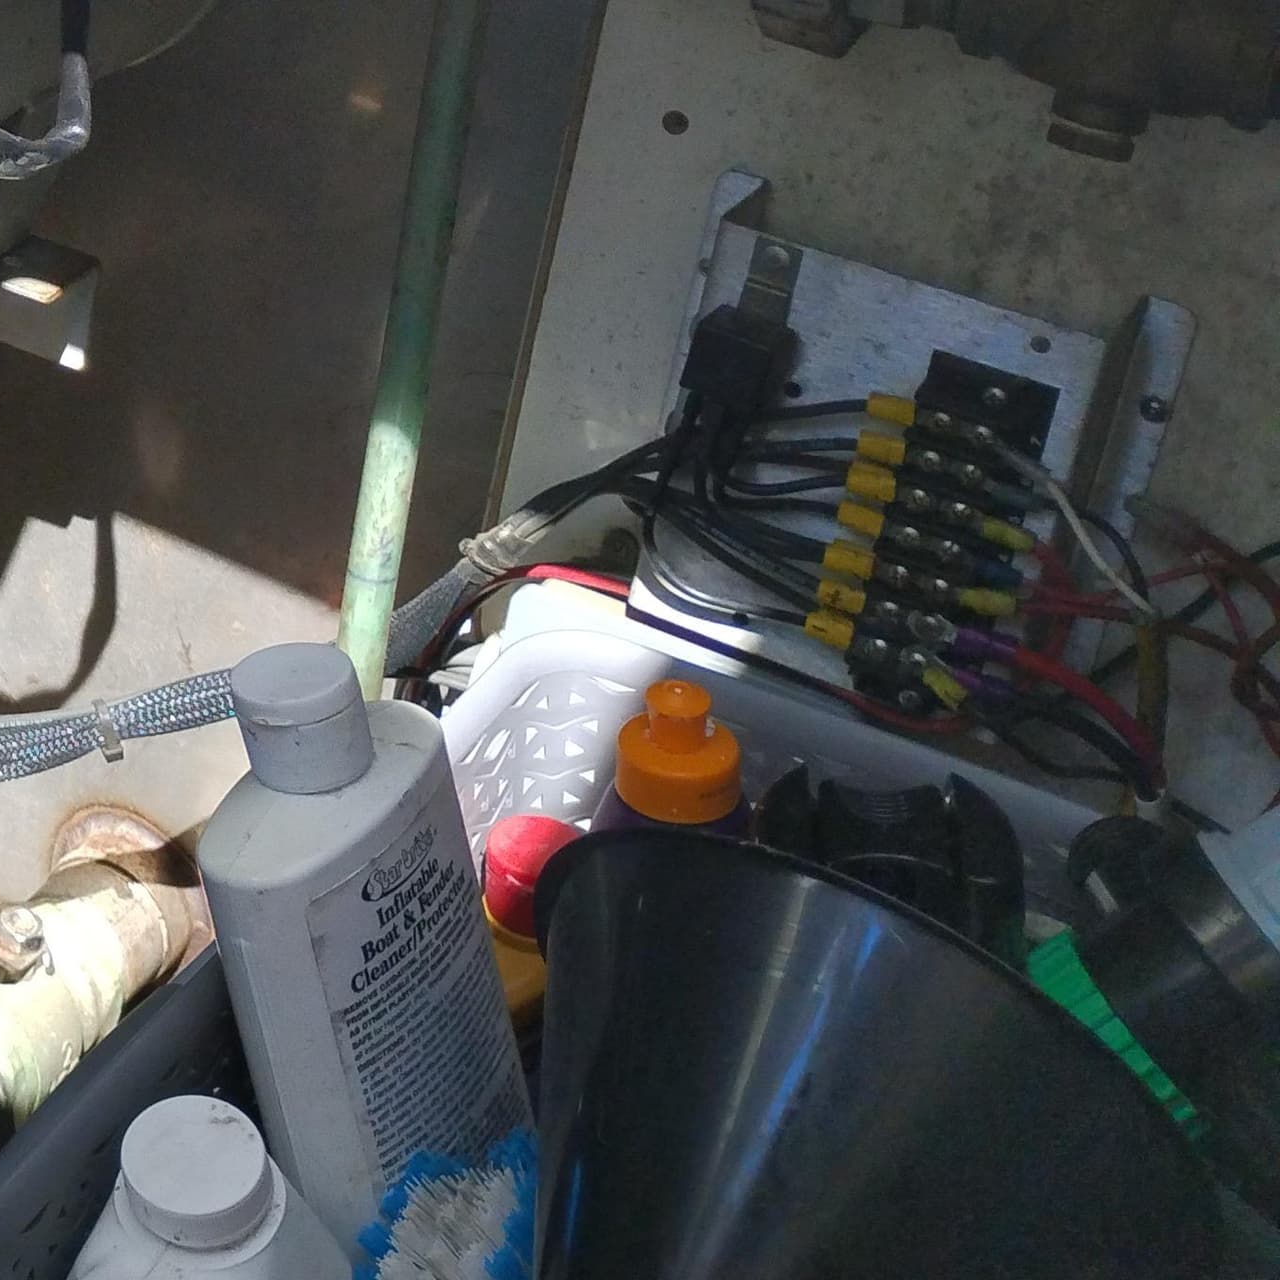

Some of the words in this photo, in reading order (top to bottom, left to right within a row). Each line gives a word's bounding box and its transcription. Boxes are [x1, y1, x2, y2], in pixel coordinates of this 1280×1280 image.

[360, 921, 401, 964] Boat
[403, 909, 417, 931] &
[417, 859, 455, 915] Fender
[376, 858, 440, 928] Inflatable
[350, 871, 466, 993] Cleaner/Protector
[344, 989, 377, 1016] REMOVE
[346, 1007, 369, 1027] FROM
[369, 975, 409, 1011] INFLATABLE
[349, 1026, 360, 1038] AS
[361, 1007, 387, 1029] OTHER
[388, 982, 416, 1011] PLASTIC
